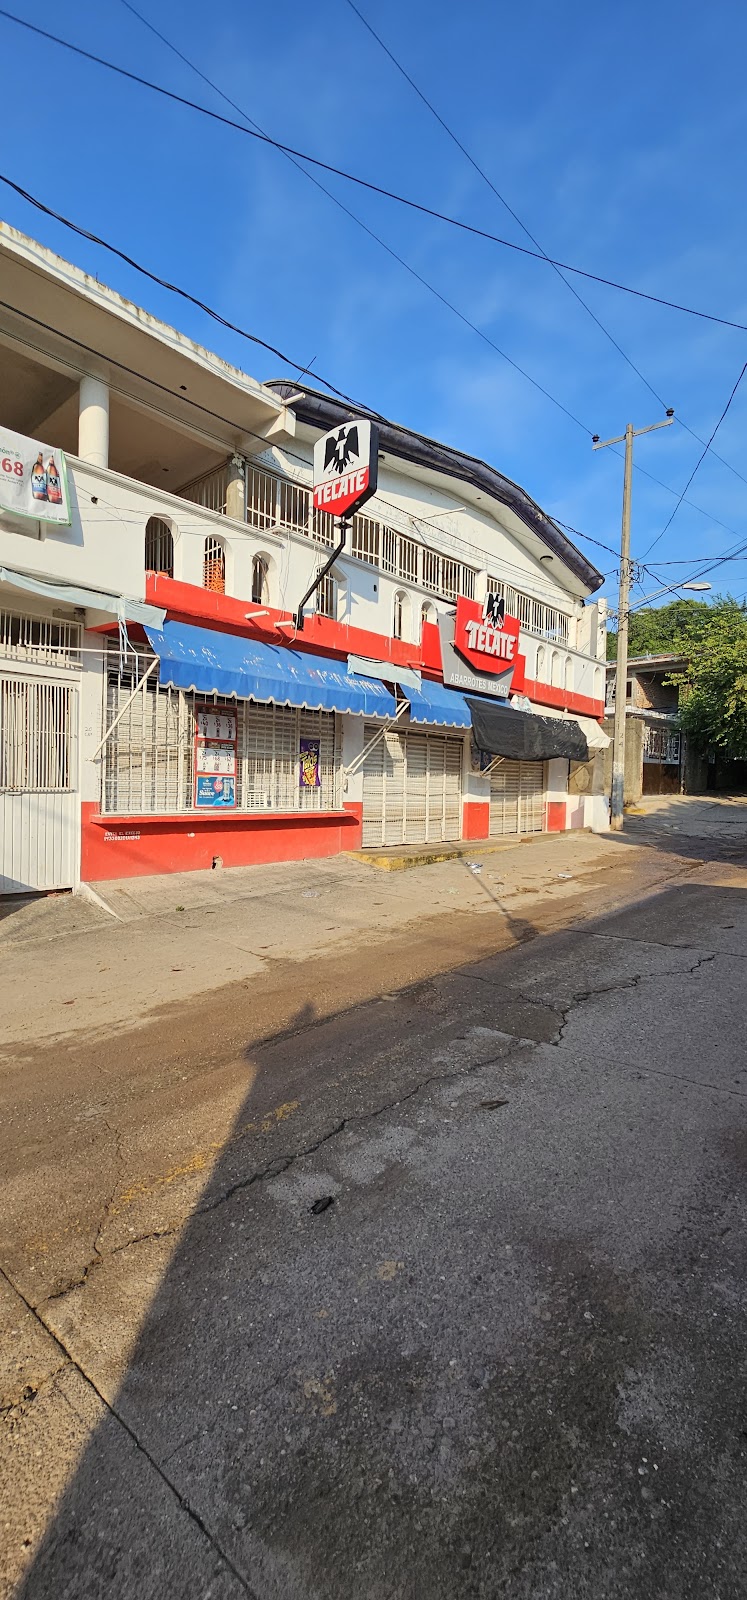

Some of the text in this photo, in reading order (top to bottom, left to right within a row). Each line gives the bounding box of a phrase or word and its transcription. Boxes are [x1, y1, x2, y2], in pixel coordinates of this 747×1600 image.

[314, 467, 367, 506] TECATE
[465, 620, 517, 661] TECATE
[450, 672, 487, 690] ABARROTES
